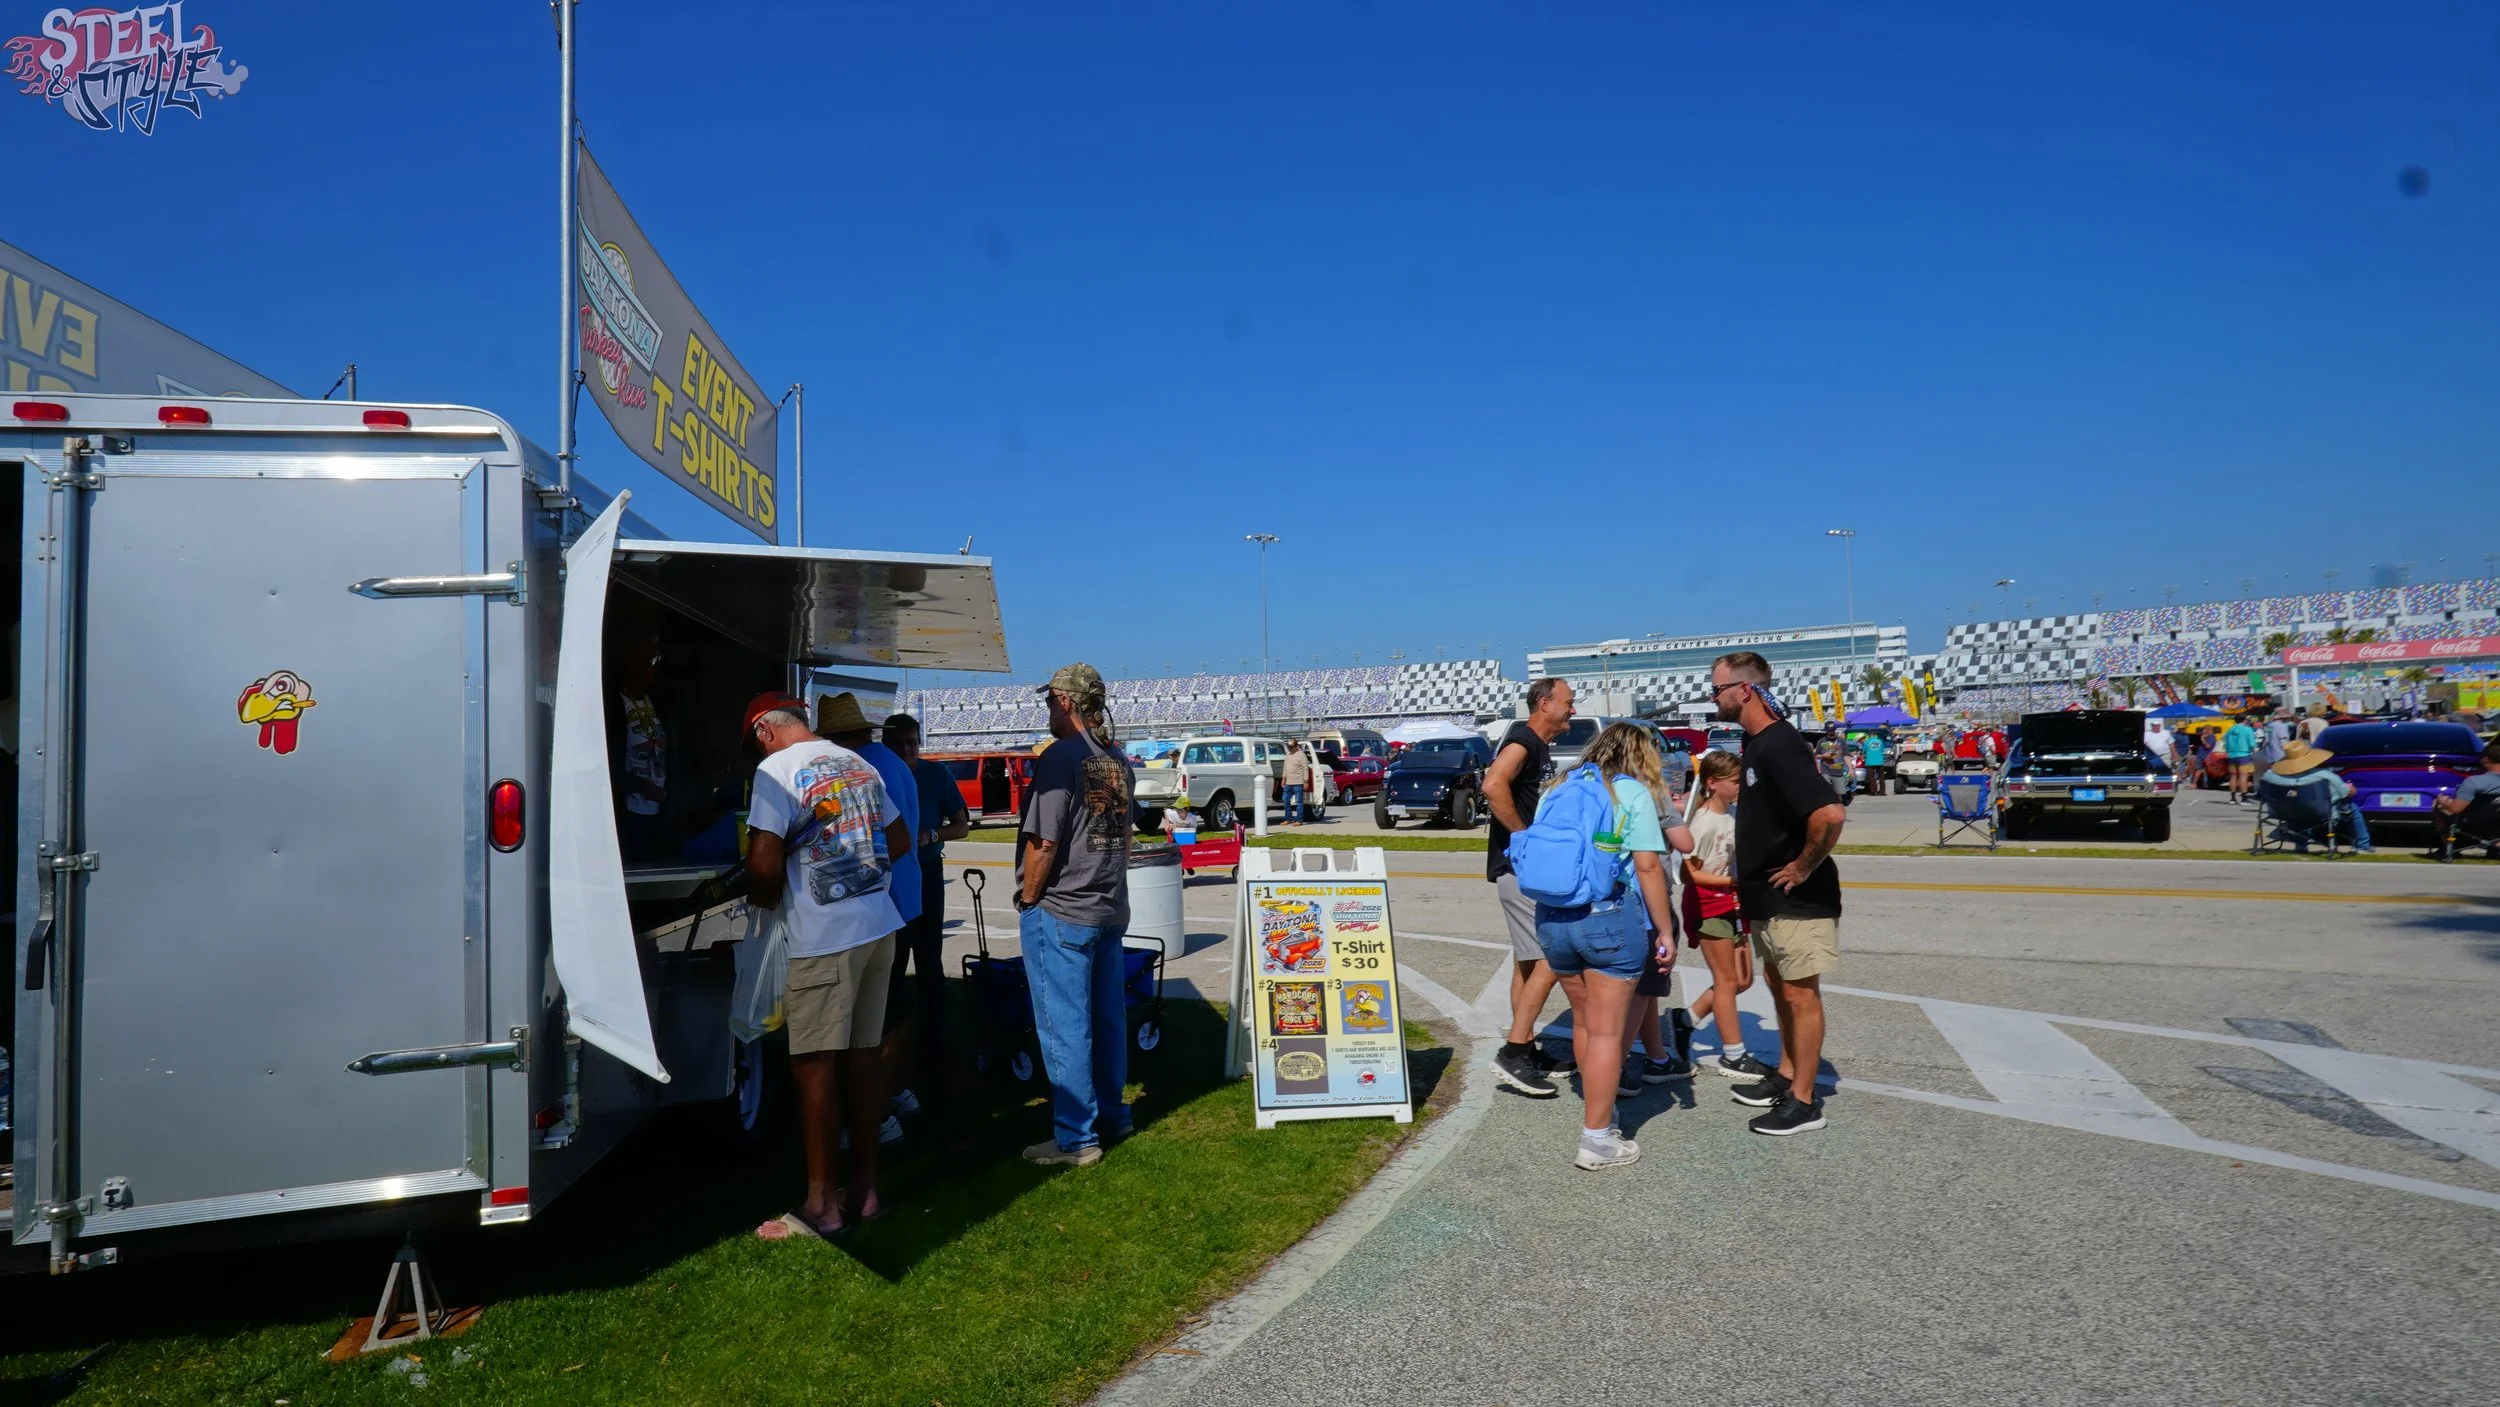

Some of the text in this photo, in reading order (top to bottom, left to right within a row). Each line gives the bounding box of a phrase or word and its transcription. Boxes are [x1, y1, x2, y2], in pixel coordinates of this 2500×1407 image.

[581, 238, 652, 358] DAYTONA
[580, 303, 624, 378] Turkey
[616, 362, 647, 409] Run
[680, 329, 755, 450] EVENT
[652, 371, 775, 529] T-SHIRTS
[1621, 635, 1783, 653] WORLD CENTER OF RACING
[1254, 886, 1383, 899] #1 OFFICIALLY LICENSED
[1262, 913, 1318, 932] DAYTONA
[1332, 940, 1386, 954] T-Shirt
[1342, 957, 1379, 969] $30
[1258, 979, 1275, 991] #2
[1326, 978, 1343, 990] #3
[1278, 990, 1317, 1002] HARDCORE
[1260, 1038, 1278, 1050] #4
